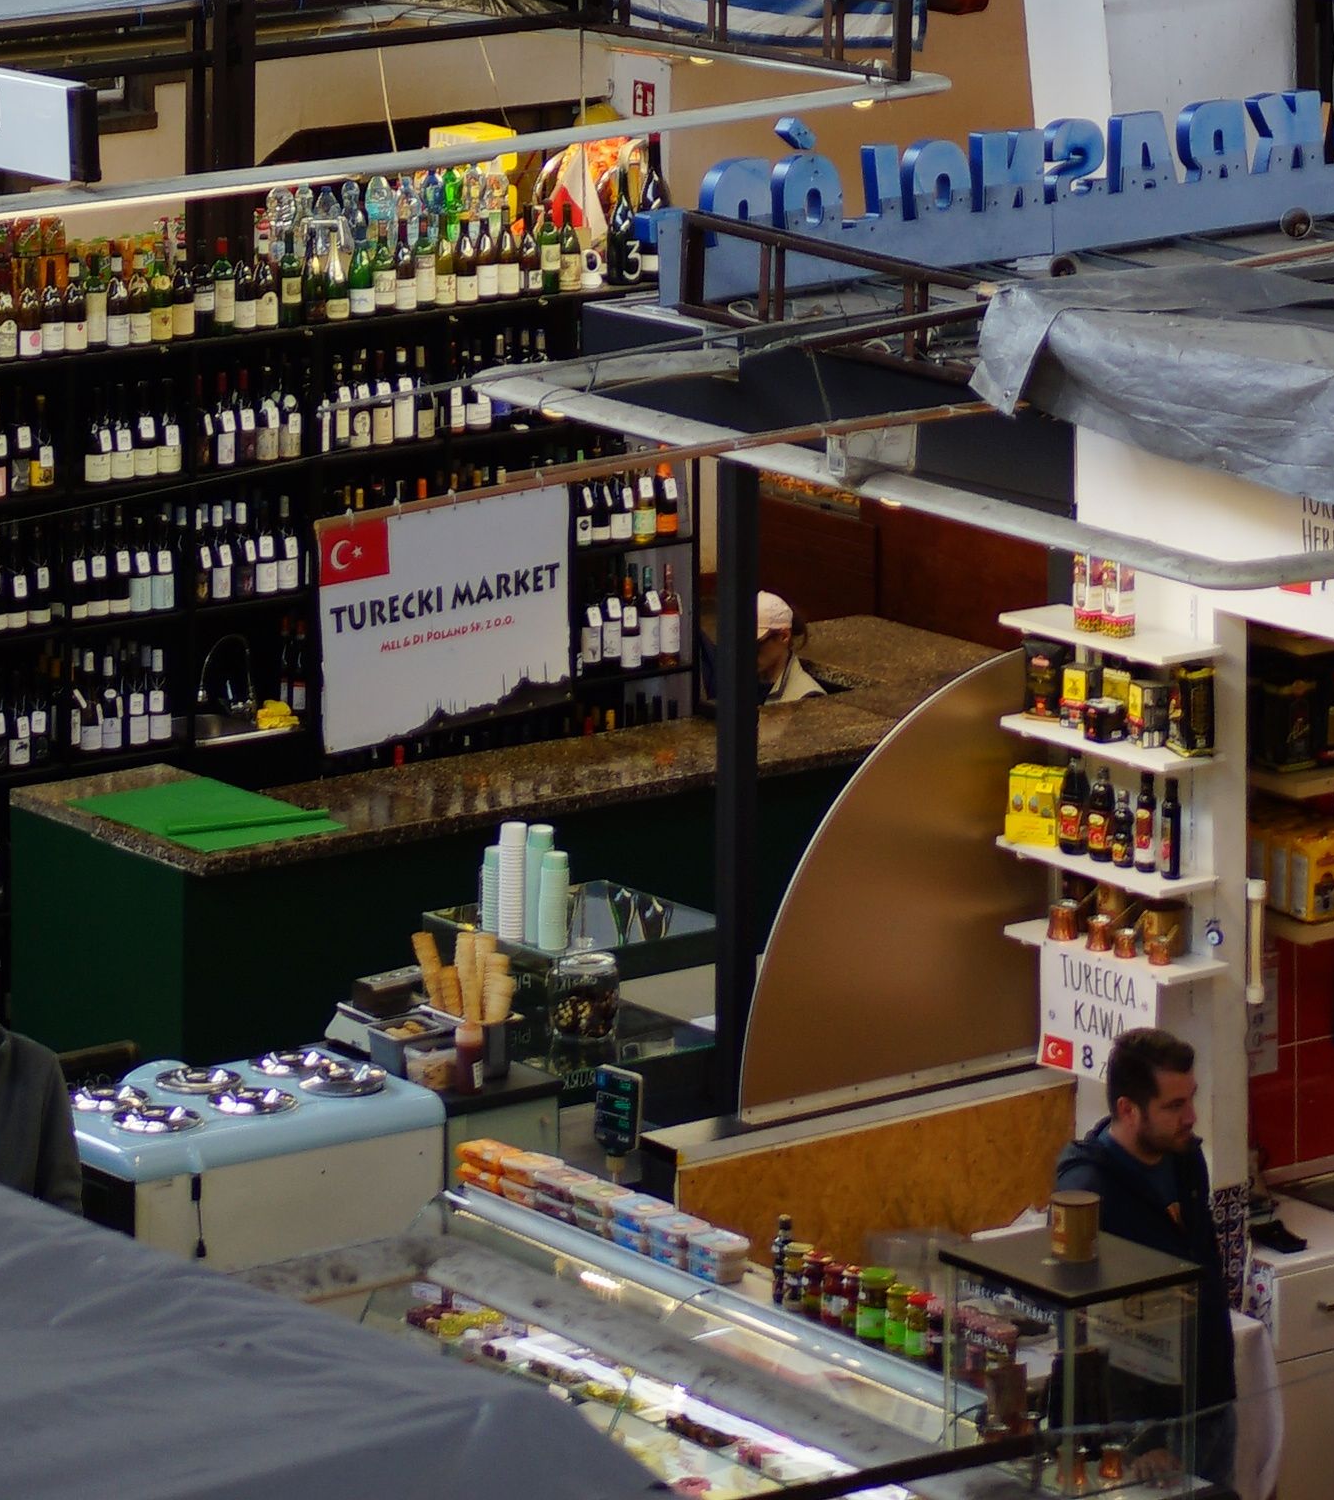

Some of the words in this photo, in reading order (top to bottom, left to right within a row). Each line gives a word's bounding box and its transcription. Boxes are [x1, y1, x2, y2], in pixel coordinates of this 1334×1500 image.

[330, 584, 443, 634] TURECKI
[451, 562, 561, 610] MARKET
[427, 626, 468, 642] POLAND
[1059, 953, 1137, 1009] TURECKA
[1073, 998, 1126, 1041] KAWA
[1082, 1044, 1094, 1070] 8
